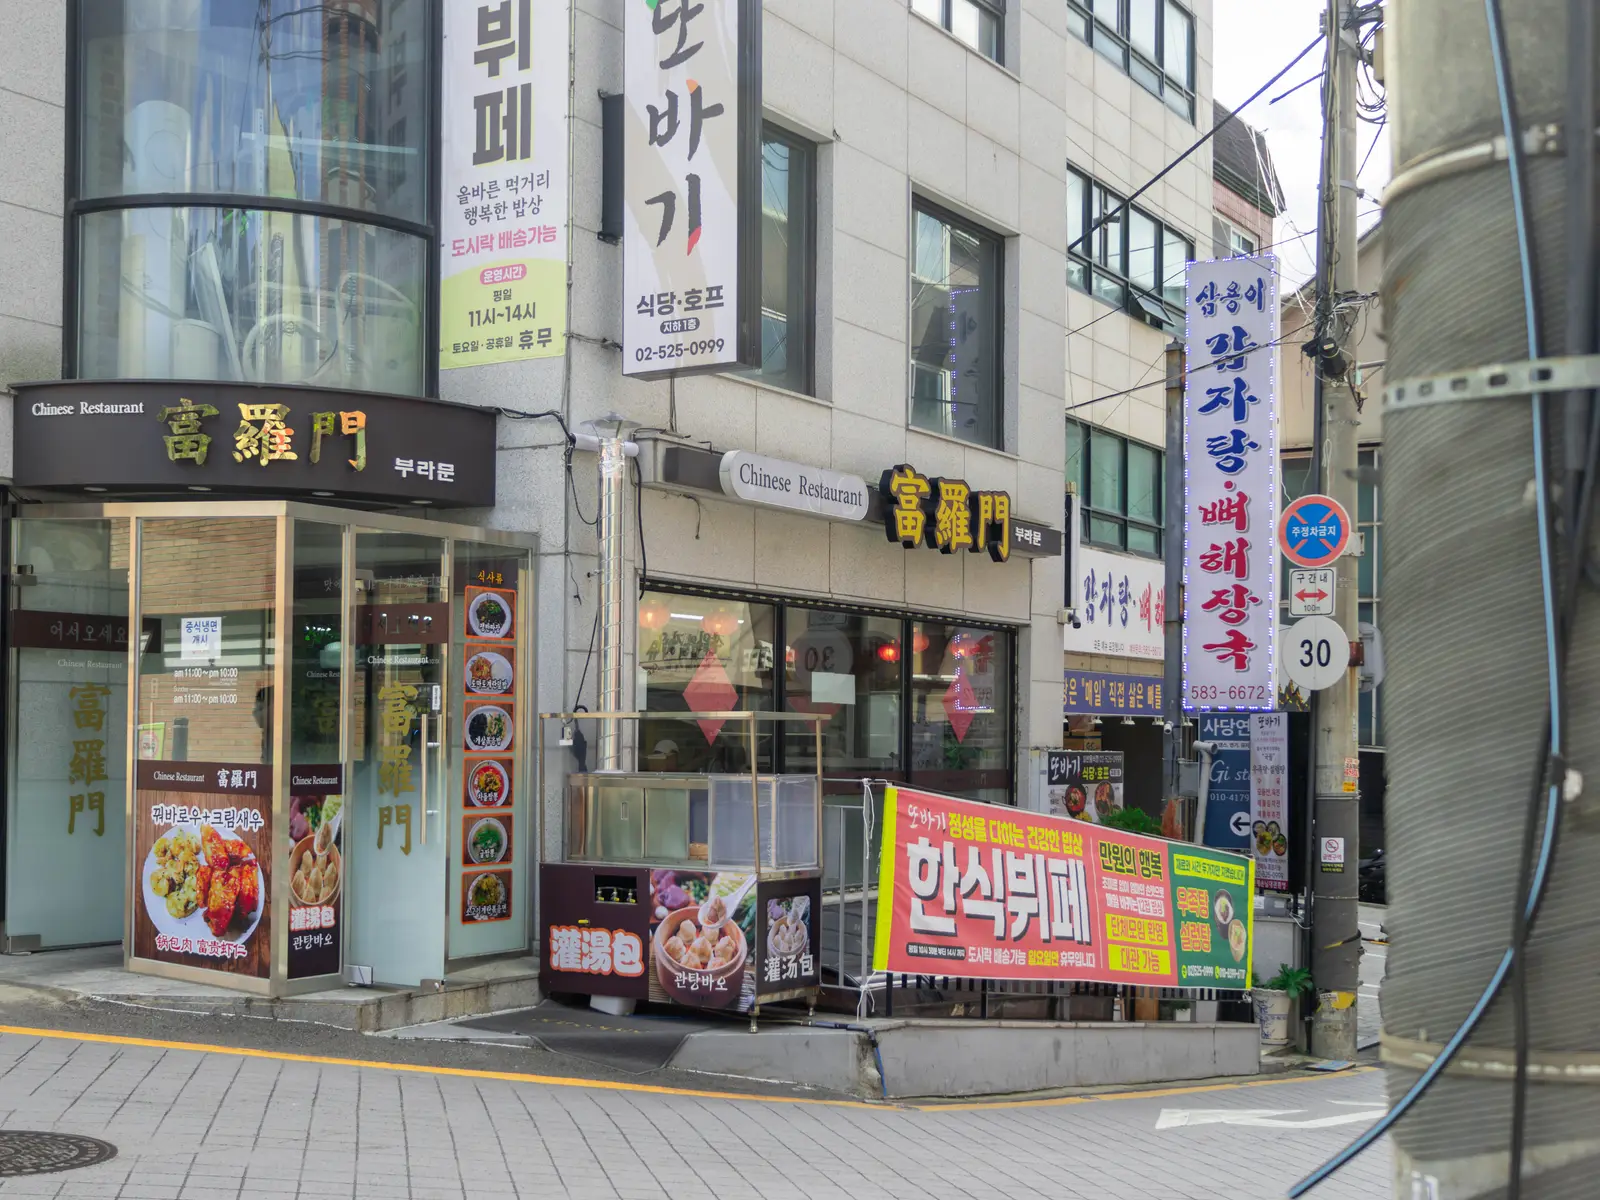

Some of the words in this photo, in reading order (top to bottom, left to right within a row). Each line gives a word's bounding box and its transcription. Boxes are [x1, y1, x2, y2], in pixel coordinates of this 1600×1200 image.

[473, 0, 533, 166] 뷔페
[645, 0, 725, 256] 또바기
[456, 180, 501, 205] 올바른
[505, 170, 550, 195] 먹거리
[464, 202, 508, 226] 행복한
[512, 195, 543, 218] 밥상
[451, 232, 495, 257] 도시락
[498, 225, 557, 250] 배송가능
[483, 265, 524, 282] 운영시간
[493, 289, 512, 302] 평일
[636, 285, 725, 317] 식당·호프
[1195, 277, 1267, 317] 삼용이
[468, 302, 537, 328] 11시~14시
[519, 327, 553, 350] 휴무
[635, 338, 725, 363] 02-525-0999
[32, 401, 74, 416] Chinese
[79, 400, 144, 415] Restaurant
[157, 397, 367, 472] 富羅門
[394, 457, 456, 483] 부라문
[739, 462, 792, 493] Chinese
[798, 474, 863, 507] Restaurant
[889, 467, 1011, 561] 富羅門
[1014, 526, 1042, 547] 부라문
[1291, 525, 1337, 538] 주정차금지
[477, 570, 504, 585] 식사류
[1303, 604, 1321, 613] 100m
[50, 621, 128, 643] 어서오세요
[185, 620, 218, 634] 중식냉면
[192, 634, 208, 646] 개시
[57, 659, 86, 668] Chinese
[87, 660, 122, 669] Restaurant
[367, 655, 393, 665] Chinese
[394, 655, 429, 665] Restaurant
[1299, 639, 1332, 668] 30
[1109, 681, 1125, 708] 직접
[1128, 682, 1144, 709] 삶은
[1190, 685, 1265, 700] 583-6672
[67, 681, 112, 837] 富羅門
[1050, 755, 1081, 781] 또바기
[153, 770, 175, 781] Chinese
[176, 772, 205, 783] Restaurant
[216, 768, 258, 789] 富羅門
[292, 775, 312, 785] Chinese
[312, 775, 338, 785] Restaurant
[152, 805, 264, 831] 꿔바로우+크림새우
[907, 803, 947, 833] 또바기
[948, 812, 987, 843] 정성을
[1026, 824, 1061, 853] 건강한
[1061, 830, 1083, 857] 밥상
[1098, 840, 1138, 877] 만원의
[1138, 848, 1164, 882] 행복
[906, 836, 1092, 945] 한식뷔페
[1176, 886, 1210, 919] 우족탕
[292, 933, 334, 950] 관탕바오
[1111, 916, 1146, 941] 단체모임
[1148, 918, 1164, 943] 환영
[1180, 921, 1212, 952] 설렁탕
[155, 935, 193, 952] 锅包肉
[196, 939, 248, 959] 富贵虾仁
[967, 946, 992, 964] 도시락
[993, 947, 1026, 965] 배송가능
[1028, 949, 1059, 967] 일요일만
[1060, 950, 1096, 968] 휴무입니다
[1120, 948, 1140, 970] 대관
[1143, 949, 1160, 972] 가능
[764, 952, 814, 982] 灌汤包
[673, 971, 728, 992] 관탕바오
